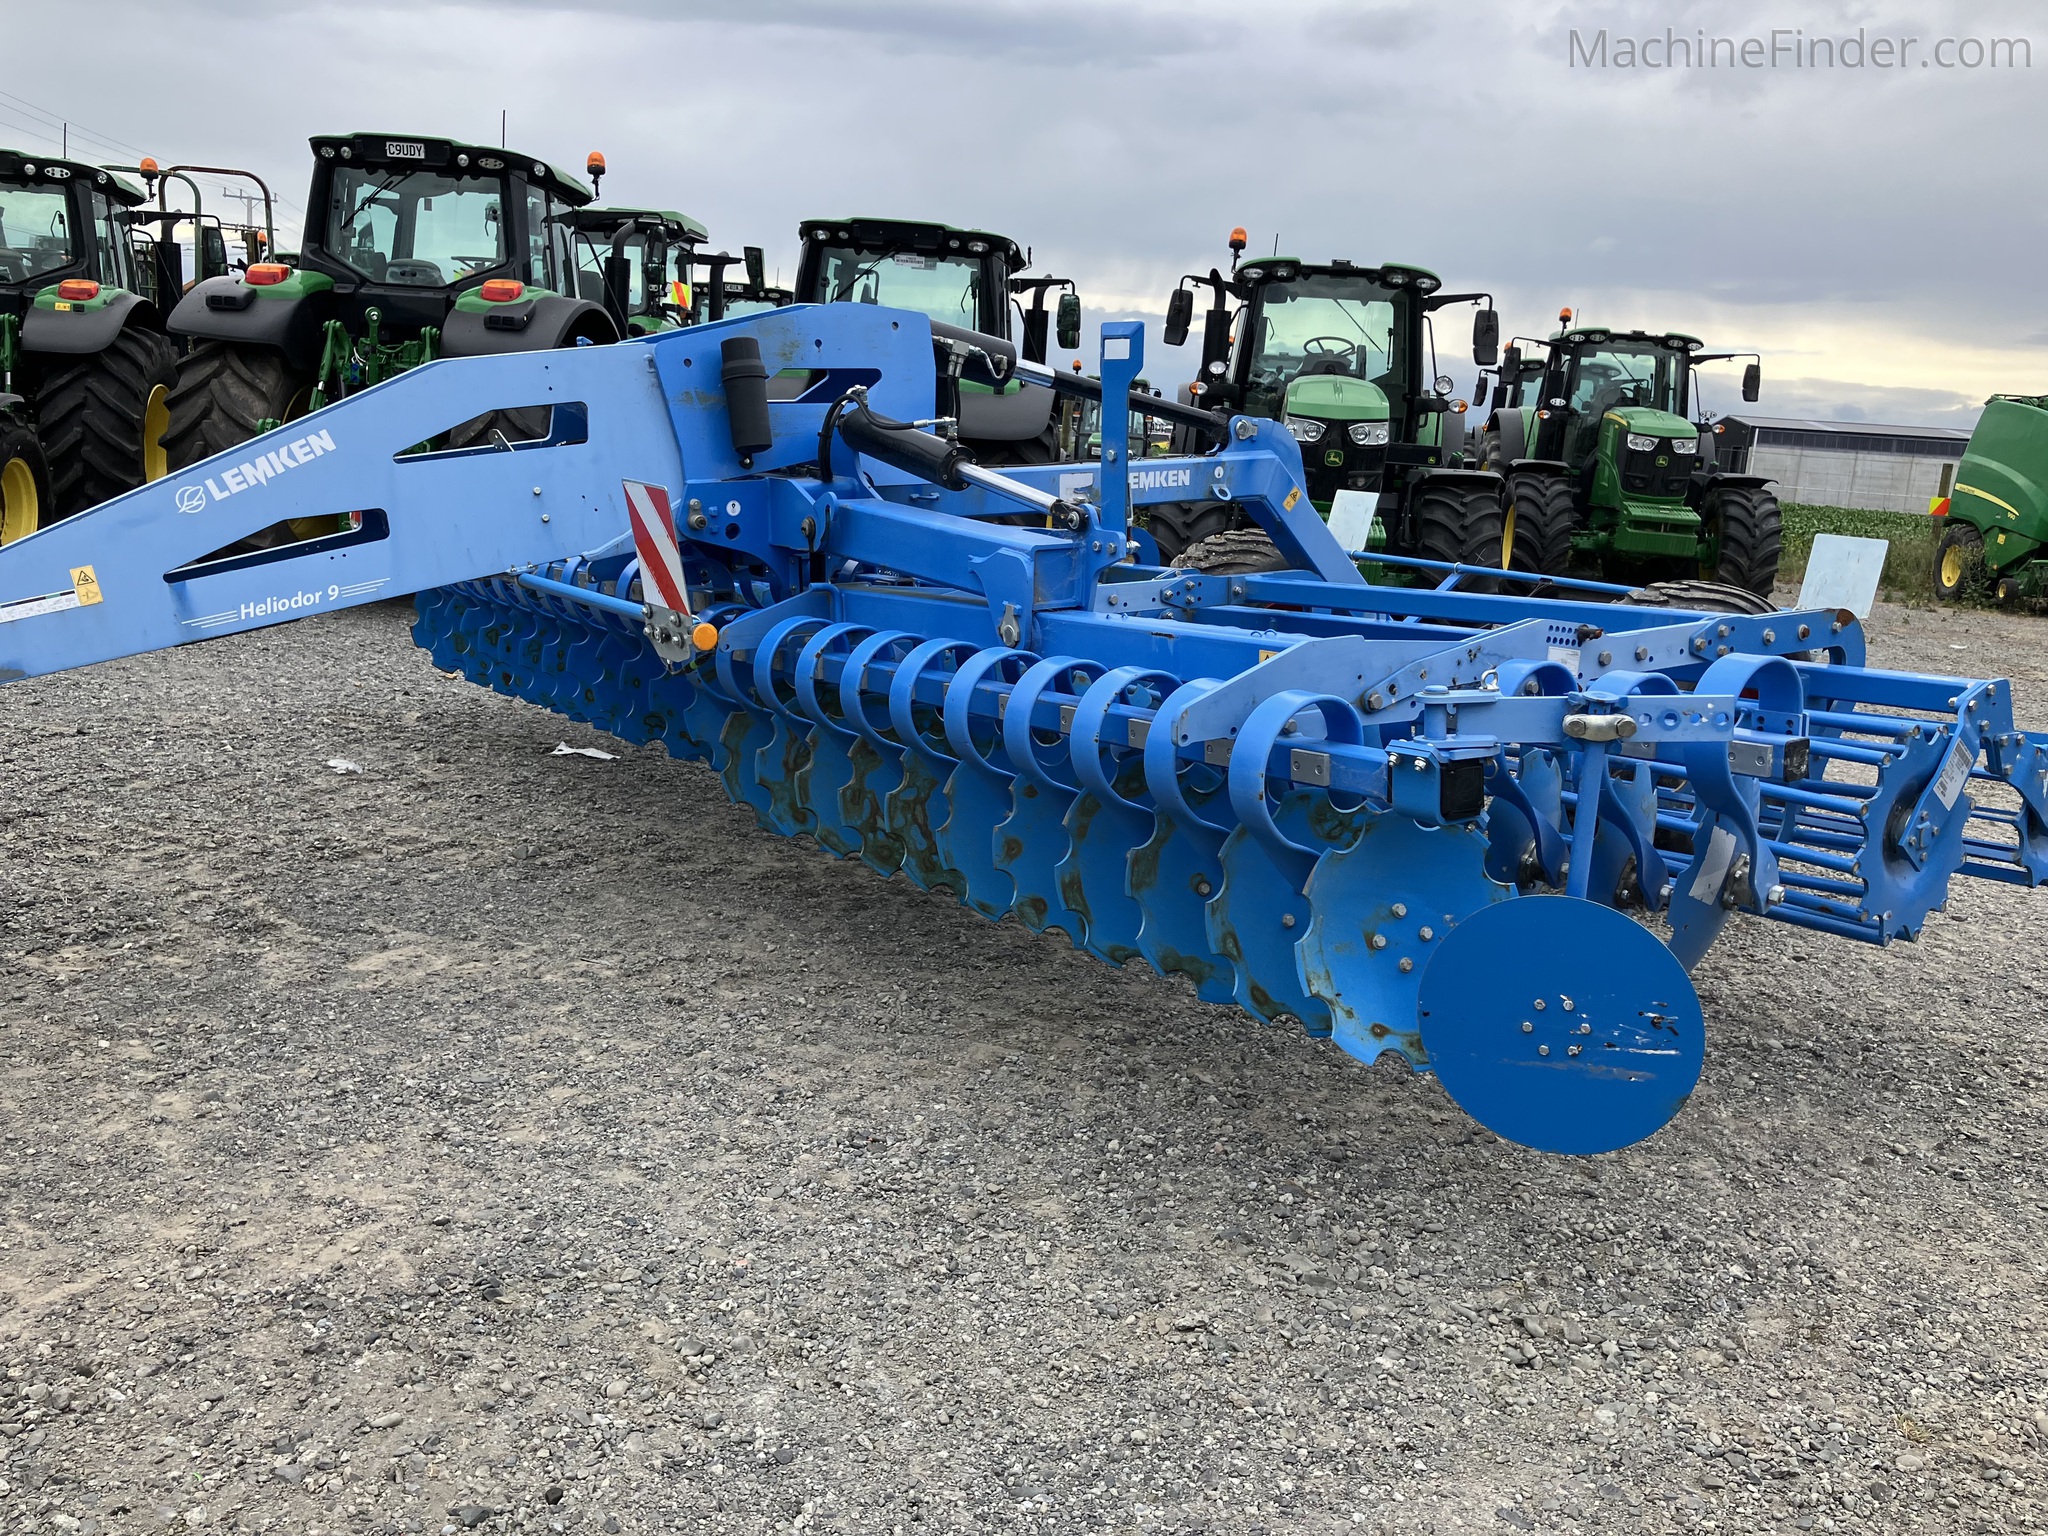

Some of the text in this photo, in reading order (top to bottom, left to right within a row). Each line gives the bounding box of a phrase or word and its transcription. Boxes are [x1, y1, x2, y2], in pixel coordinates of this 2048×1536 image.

[388, 143, 423, 157] C9UDY
[204, 429, 337, 501] LEMKEN
[1128, 469, 1191, 493] EMKEN
[240, 584, 340, 620] Heliodor 9
